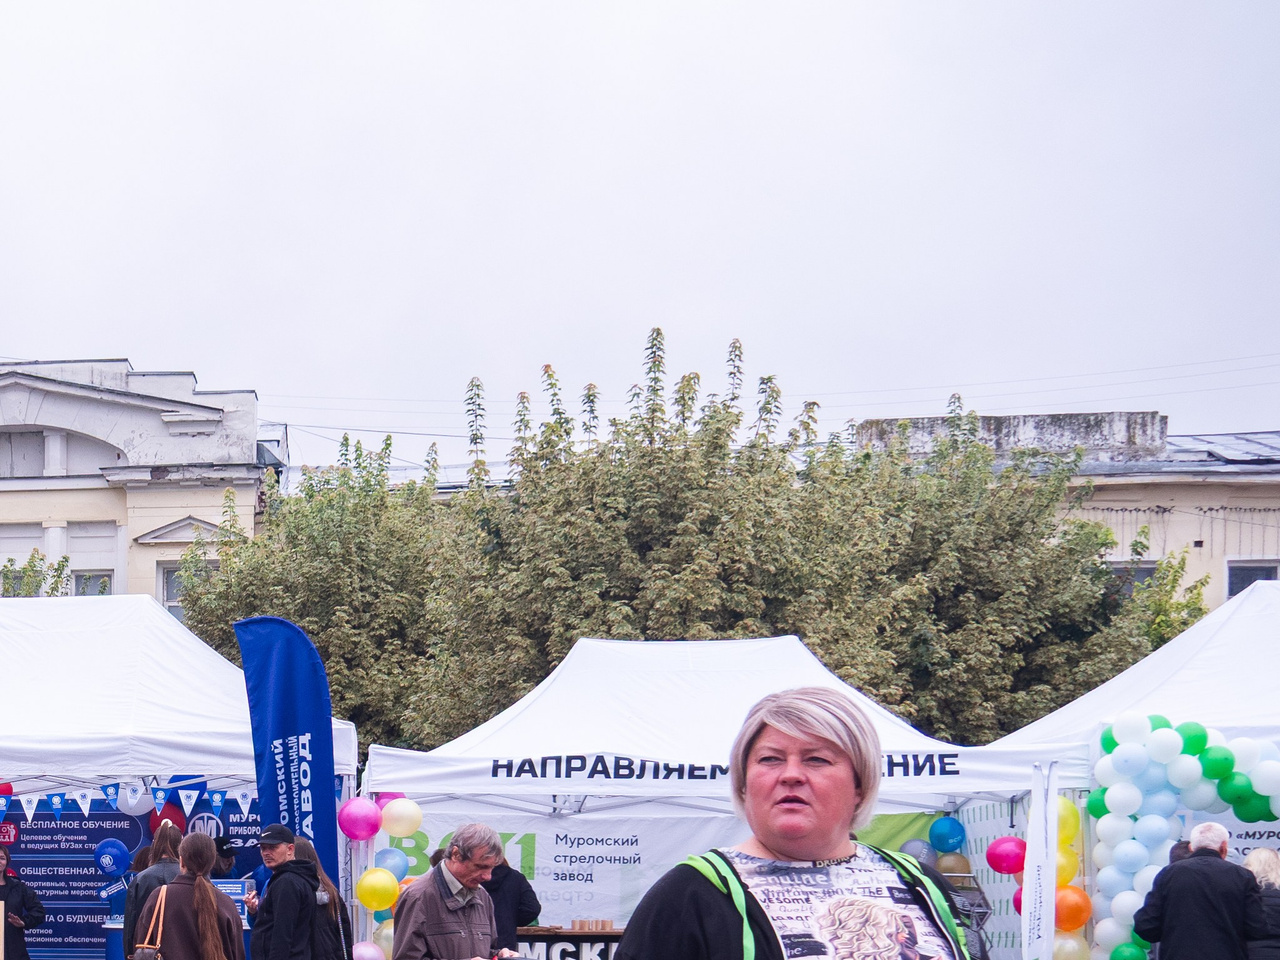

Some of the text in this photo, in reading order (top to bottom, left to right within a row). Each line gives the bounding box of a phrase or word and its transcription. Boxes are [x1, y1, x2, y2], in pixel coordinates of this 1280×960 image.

[271, 739, 289, 826] ОМСКИЙ
[298, 733, 315, 848] АВОД
[20, 821, 130, 829] БЕСПЛАТНОЕ ОБУЧЕНИЕ
[21, 834, 87, 842] Целевое обучение
[555, 833, 638, 849] Муромский
[553, 852, 641, 867] стрелочный
[20, 867, 95, 876] ОБЩЕСТВЕННАЯ
[553, 872, 593, 884] завод
